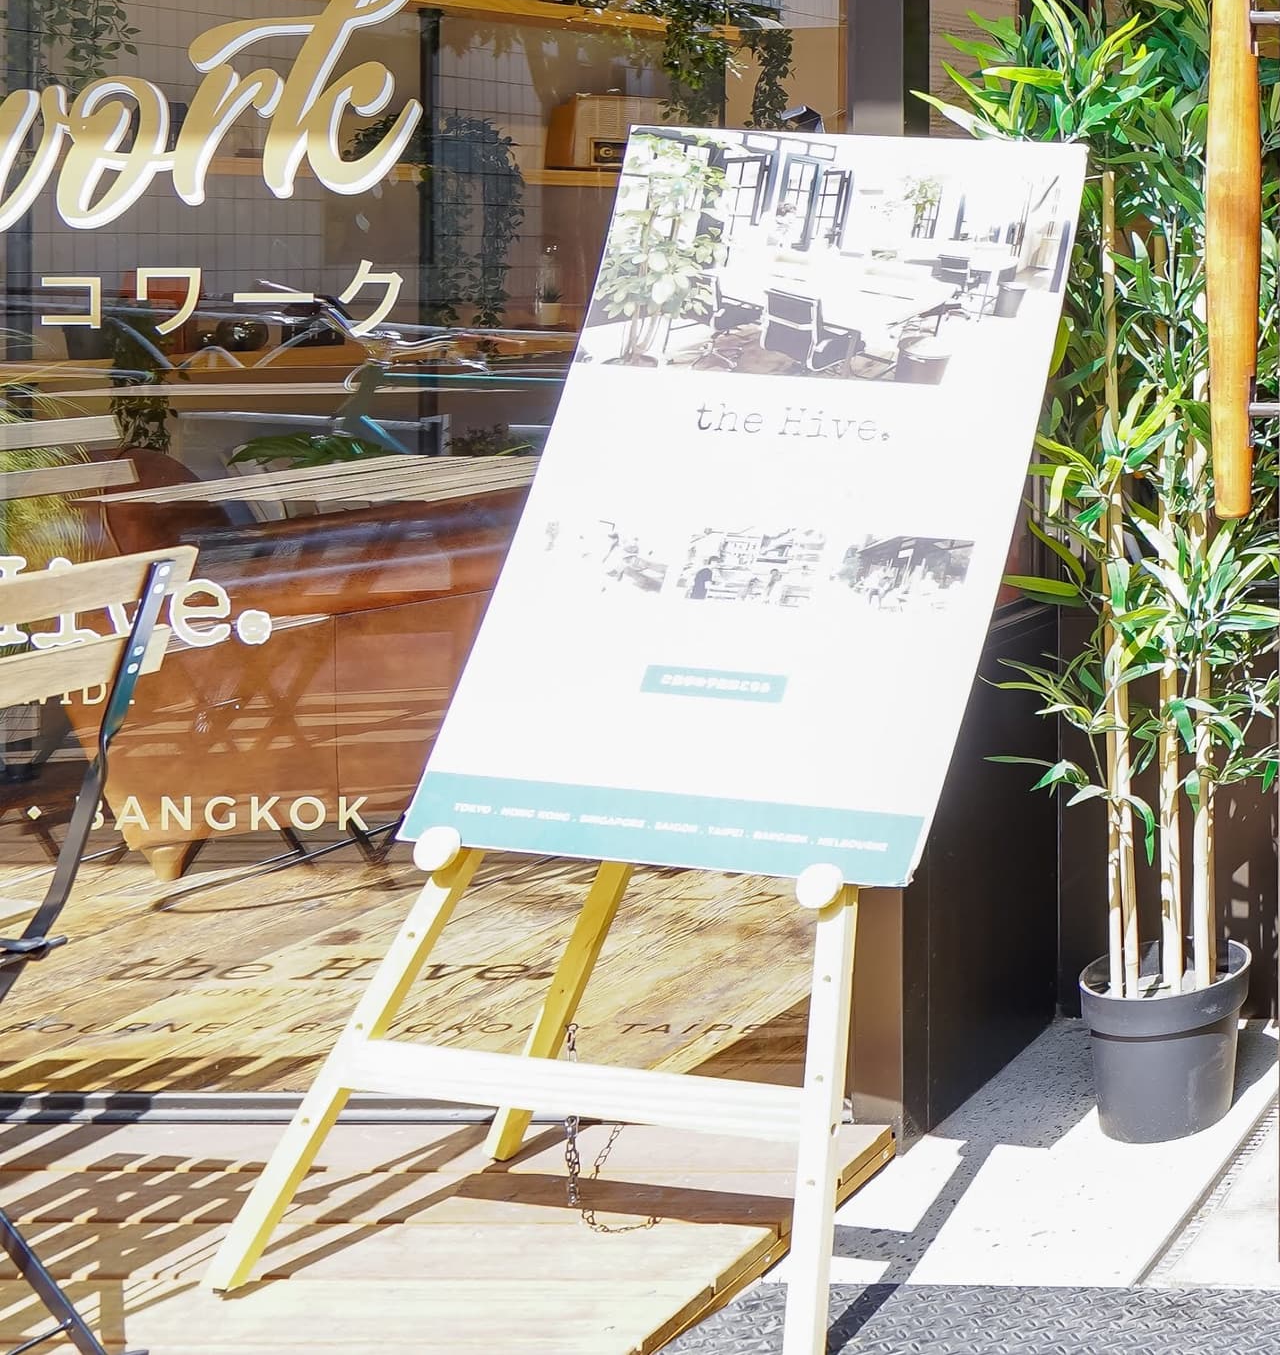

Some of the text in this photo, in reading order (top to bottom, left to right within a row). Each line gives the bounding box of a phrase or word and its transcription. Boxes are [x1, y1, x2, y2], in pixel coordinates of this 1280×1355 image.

[40, 259, 404, 338] コワーク
[696, 402, 890, 441] the Hive.
